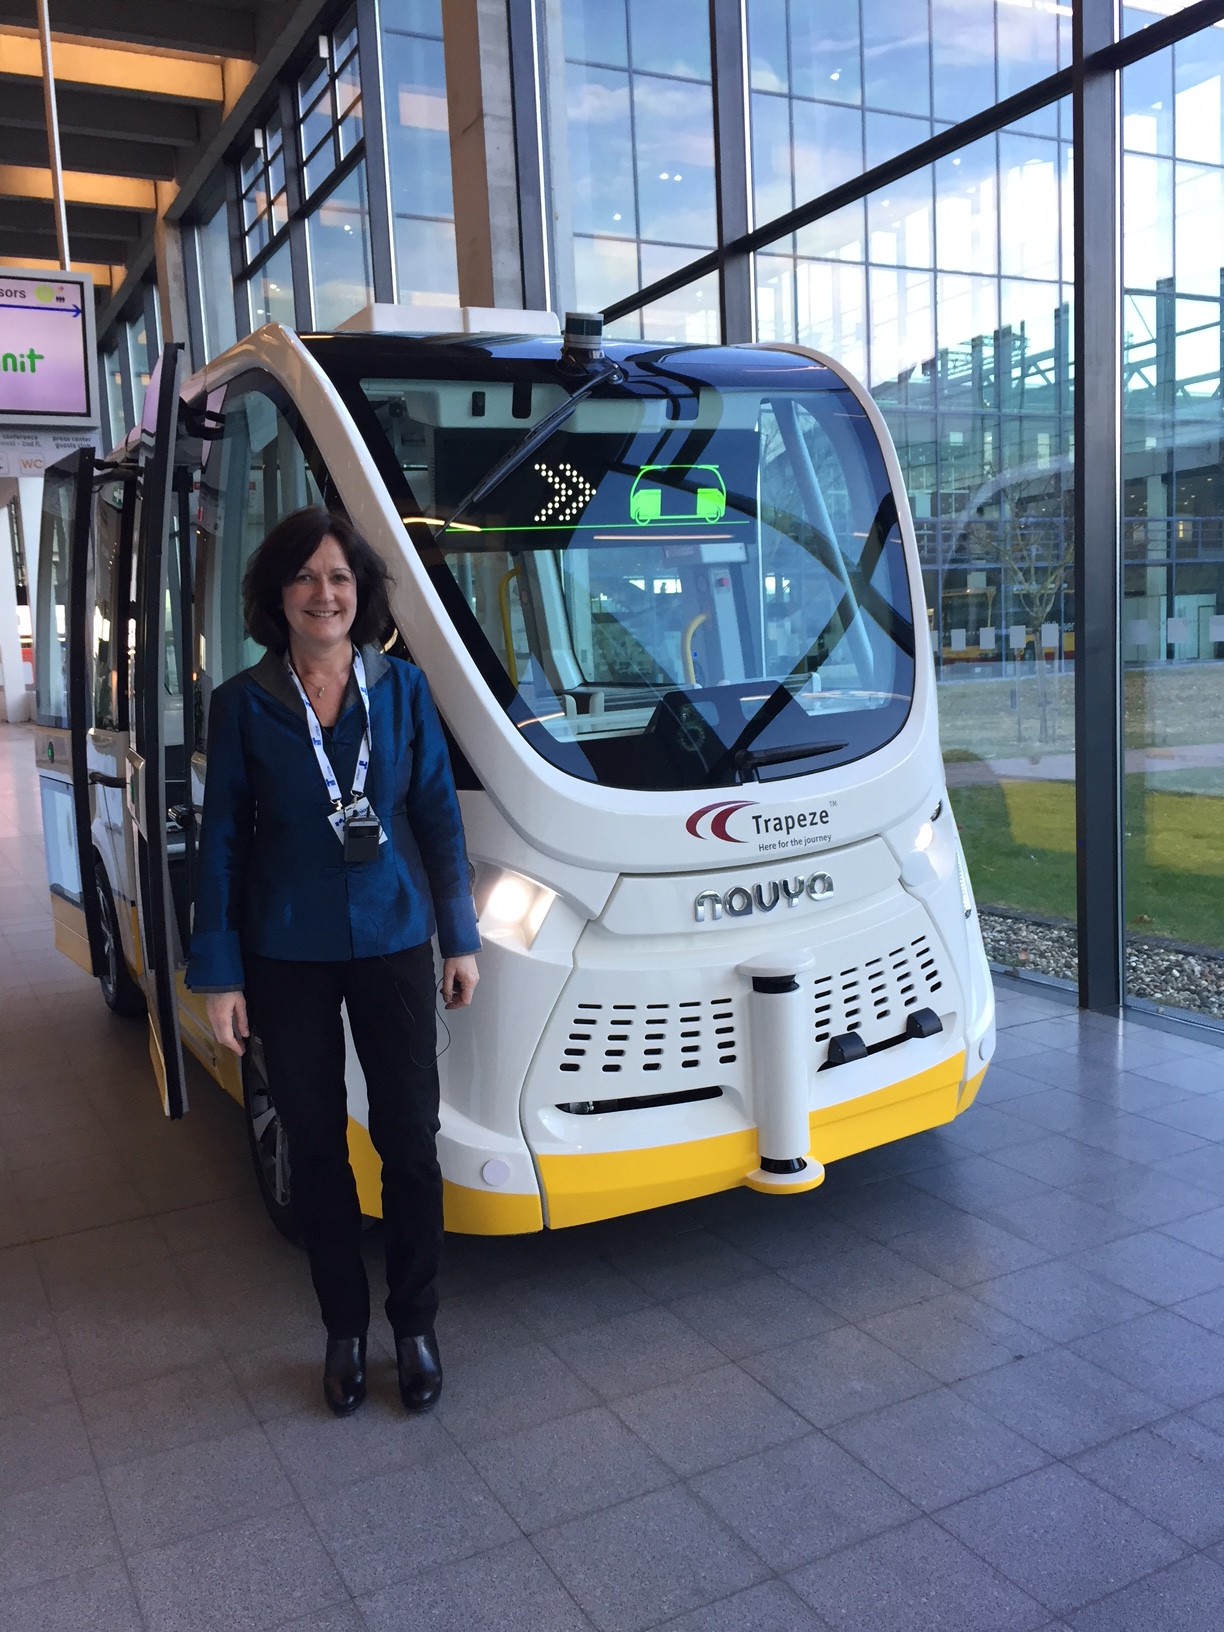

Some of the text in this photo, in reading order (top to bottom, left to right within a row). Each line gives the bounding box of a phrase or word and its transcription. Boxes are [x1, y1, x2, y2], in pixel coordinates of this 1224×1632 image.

[20, 458, 43, 469] WC
[751, 809, 829, 835] Trapeze
[758, 834, 832, 851] Here for the journey
